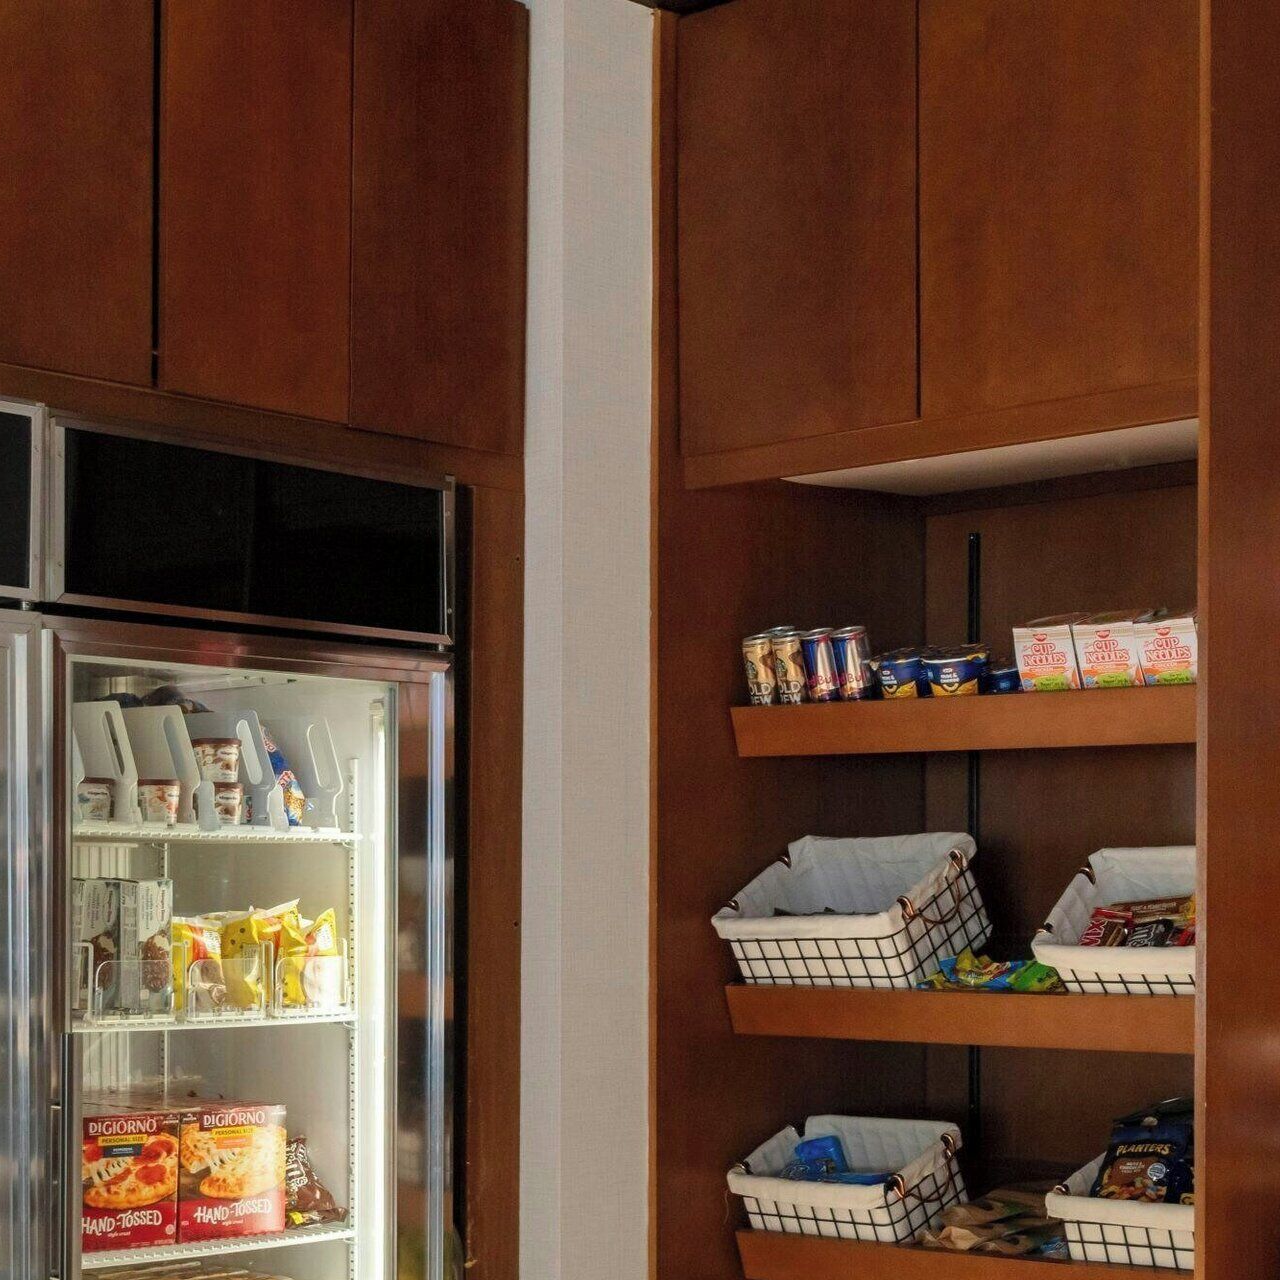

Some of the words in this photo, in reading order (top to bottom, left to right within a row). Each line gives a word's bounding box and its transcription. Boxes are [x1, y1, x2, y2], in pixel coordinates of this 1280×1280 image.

[1031, 643, 1055, 655] CUP
[1093, 640, 1118, 652] CUP
[1154, 636, 1179, 649] CUP
[1023, 652, 1066, 666] NOODLES
[1085, 650, 1129, 664] NOODLES
[1145, 646, 1191, 662] NOODLES
[215, 1129, 241, 1137] PERSONAL
[102, 1137, 131, 1145] PERSONAL
[1117, 1143, 1170, 1156] PLANTERS
[194, 1198, 272, 1224] HAND-TOSSED
[81, 1208, 162, 1235] HAND-TOSSED
